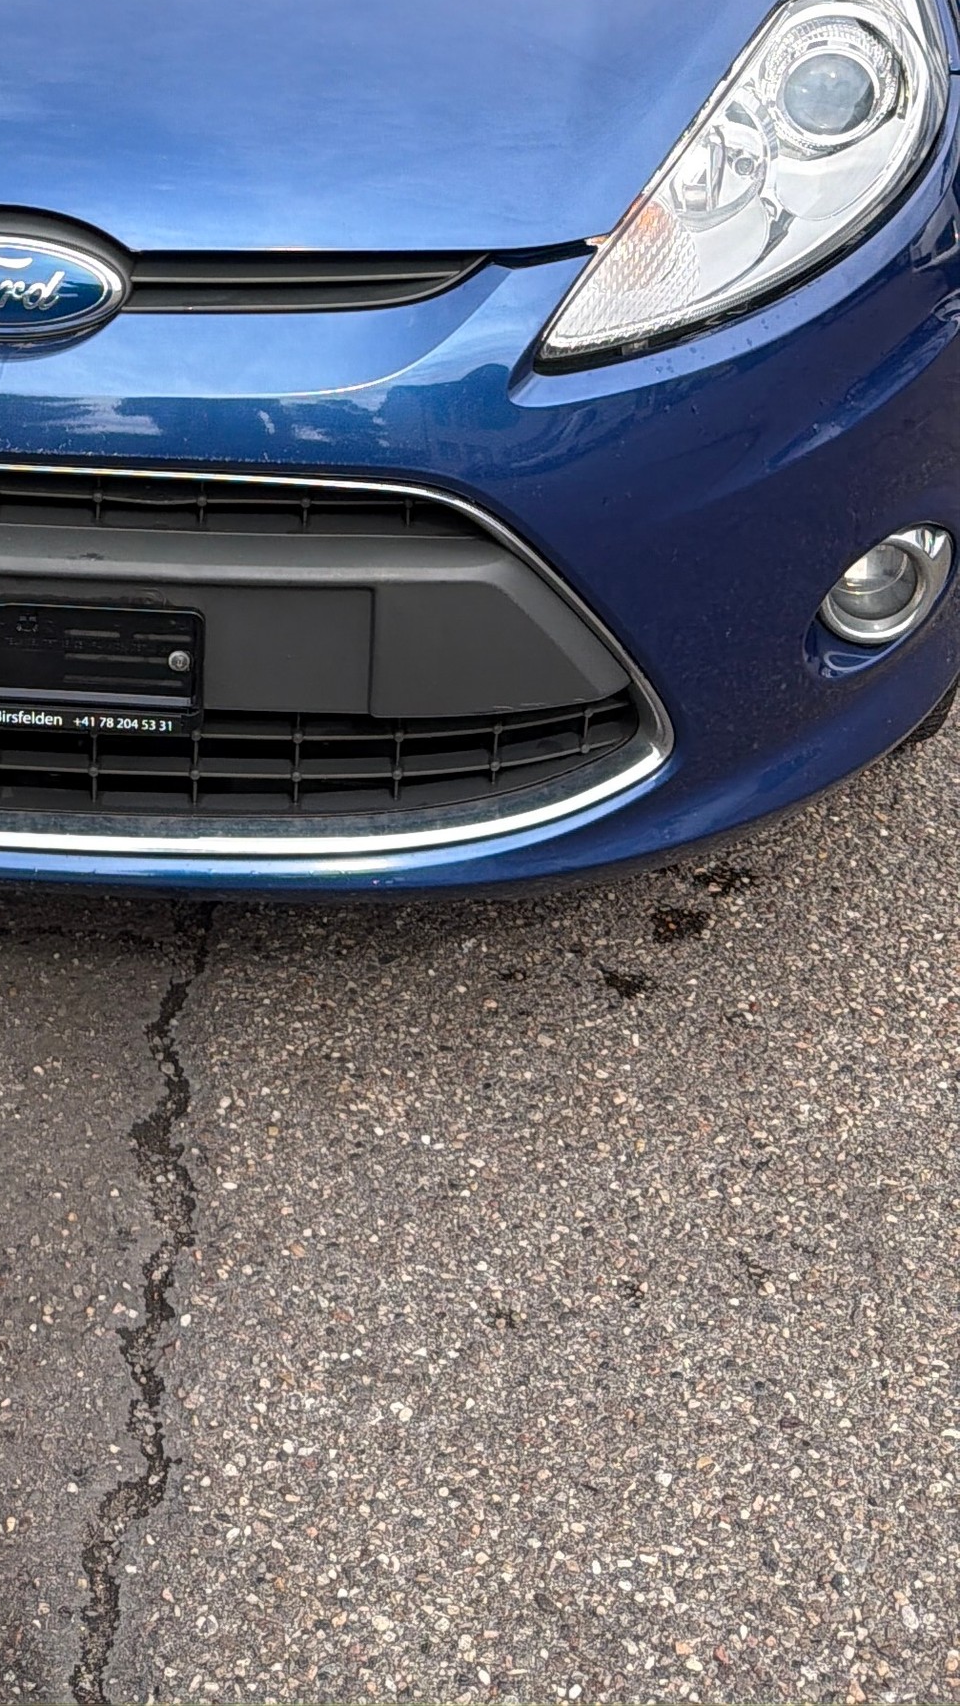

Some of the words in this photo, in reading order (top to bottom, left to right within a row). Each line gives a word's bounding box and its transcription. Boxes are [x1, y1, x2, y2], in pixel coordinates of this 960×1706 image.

[73, 715, 95, 728] +41
[99, 716, 115, 729] 78
[116, 718, 139, 731] 204
[141, 719, 156, 731] 53
[158, 720, 173, 732] 31
